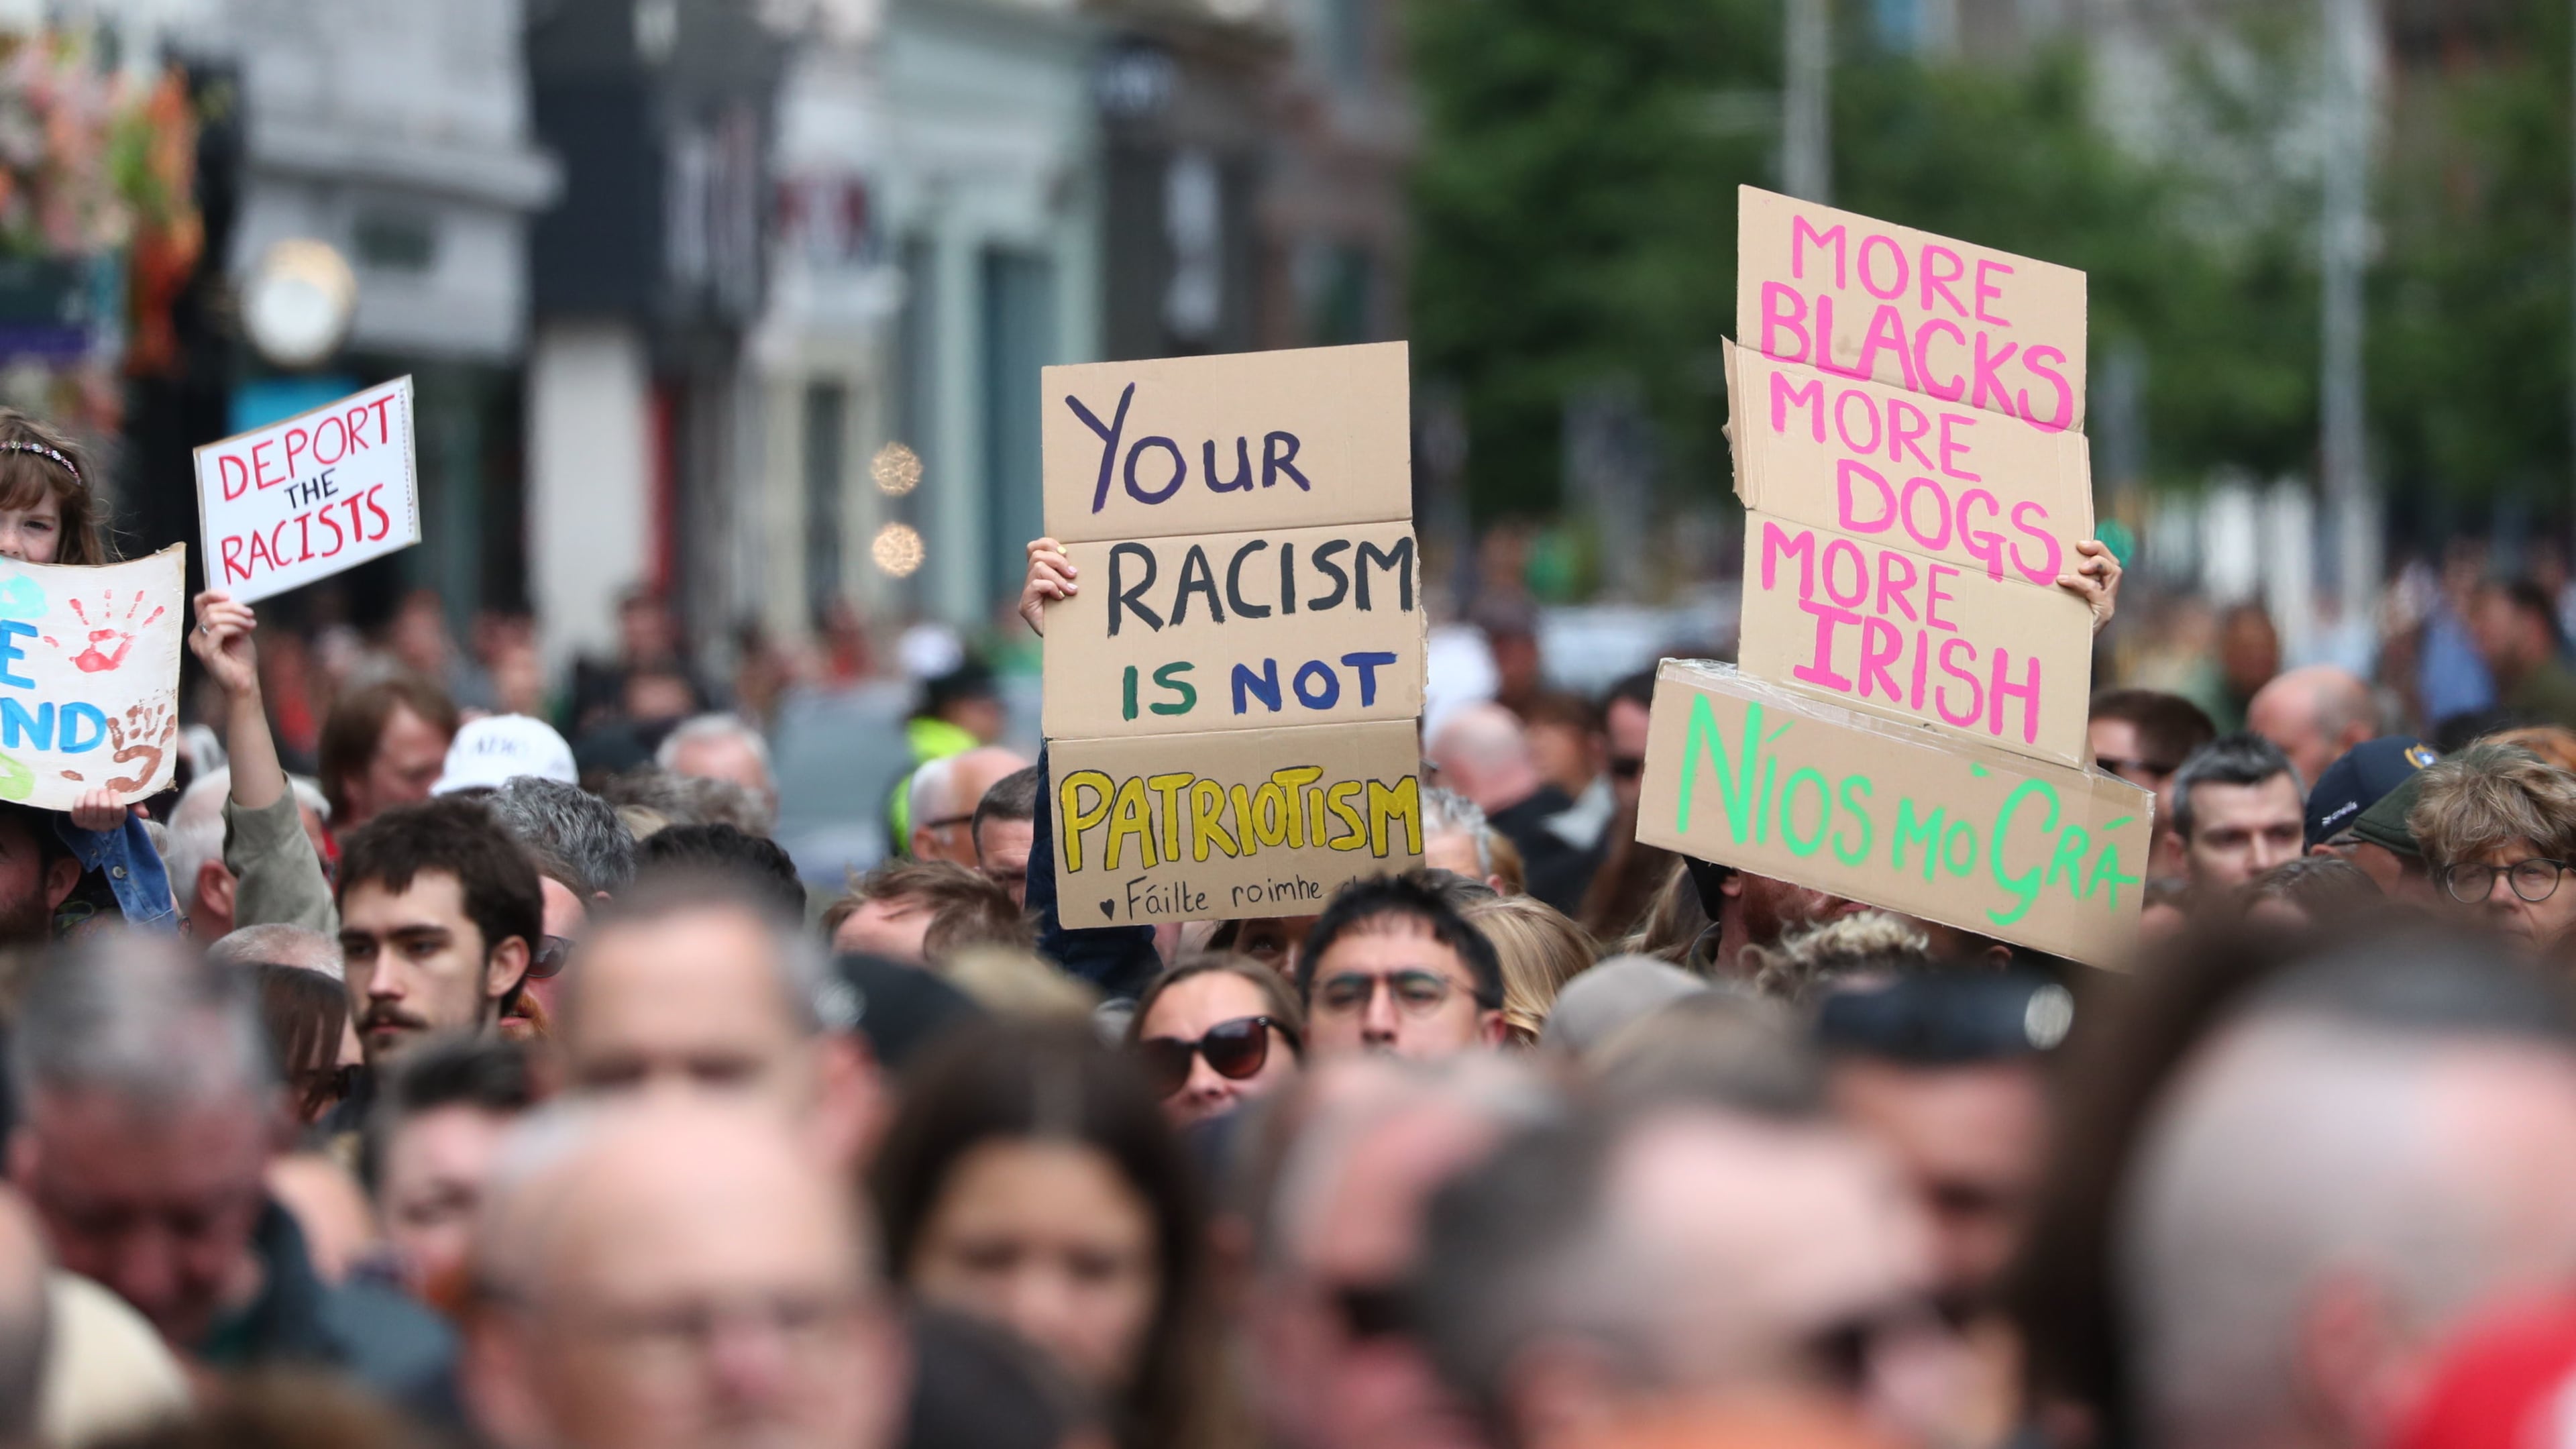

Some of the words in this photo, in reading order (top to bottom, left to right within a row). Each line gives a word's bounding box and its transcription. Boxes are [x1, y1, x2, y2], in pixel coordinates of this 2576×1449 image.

[1792, 215, 2014, 327] MORE
[1760, 280, 2074, 433] BLACKS
[218, 393, 396, 502] DEPORT
[1064, 382, 1311, 515] YOUR
[1770, 371, 1982, 482] MORE
[220, 482, 390, 586] RACISTS
[284, 467, 339, 510] THE
[1836, 458, 2063, 587] DOGS
[1107, 536, 1413, 638] RACISM
[1761, 521, 1960, 633] MORE
[1122, 661, 1197, 720] IS
[1232, 652, 1397, 714] NOT
[1792, 598, 2041, 745] IRISH
[1059, 765, 1423, 874] PATRIOTISM
[1126, 875, 1209, 920] Fáilte
[1232, 874, 1323, 908] roimhe
